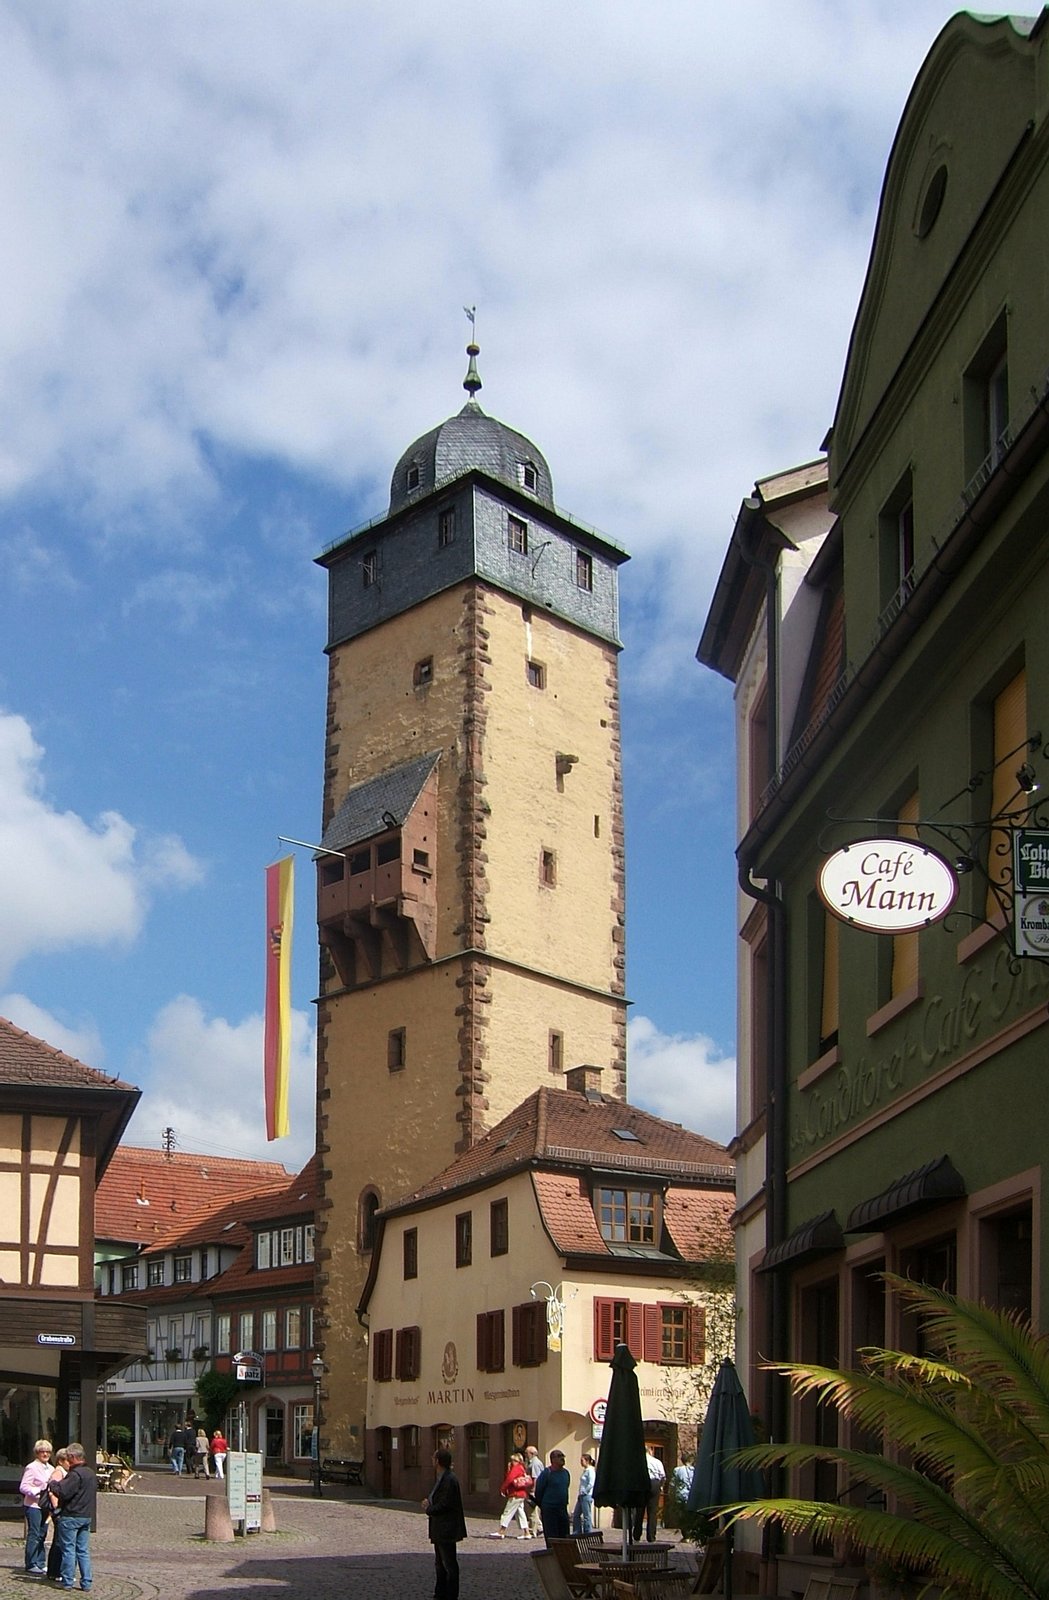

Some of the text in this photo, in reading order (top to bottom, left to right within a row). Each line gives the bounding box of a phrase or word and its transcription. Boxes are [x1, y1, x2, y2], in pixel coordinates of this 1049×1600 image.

[861, 851, 914, 882] Café
[841, 878, 937, 911] Mann
[427, 1388, 475, 1405] MARTIN
